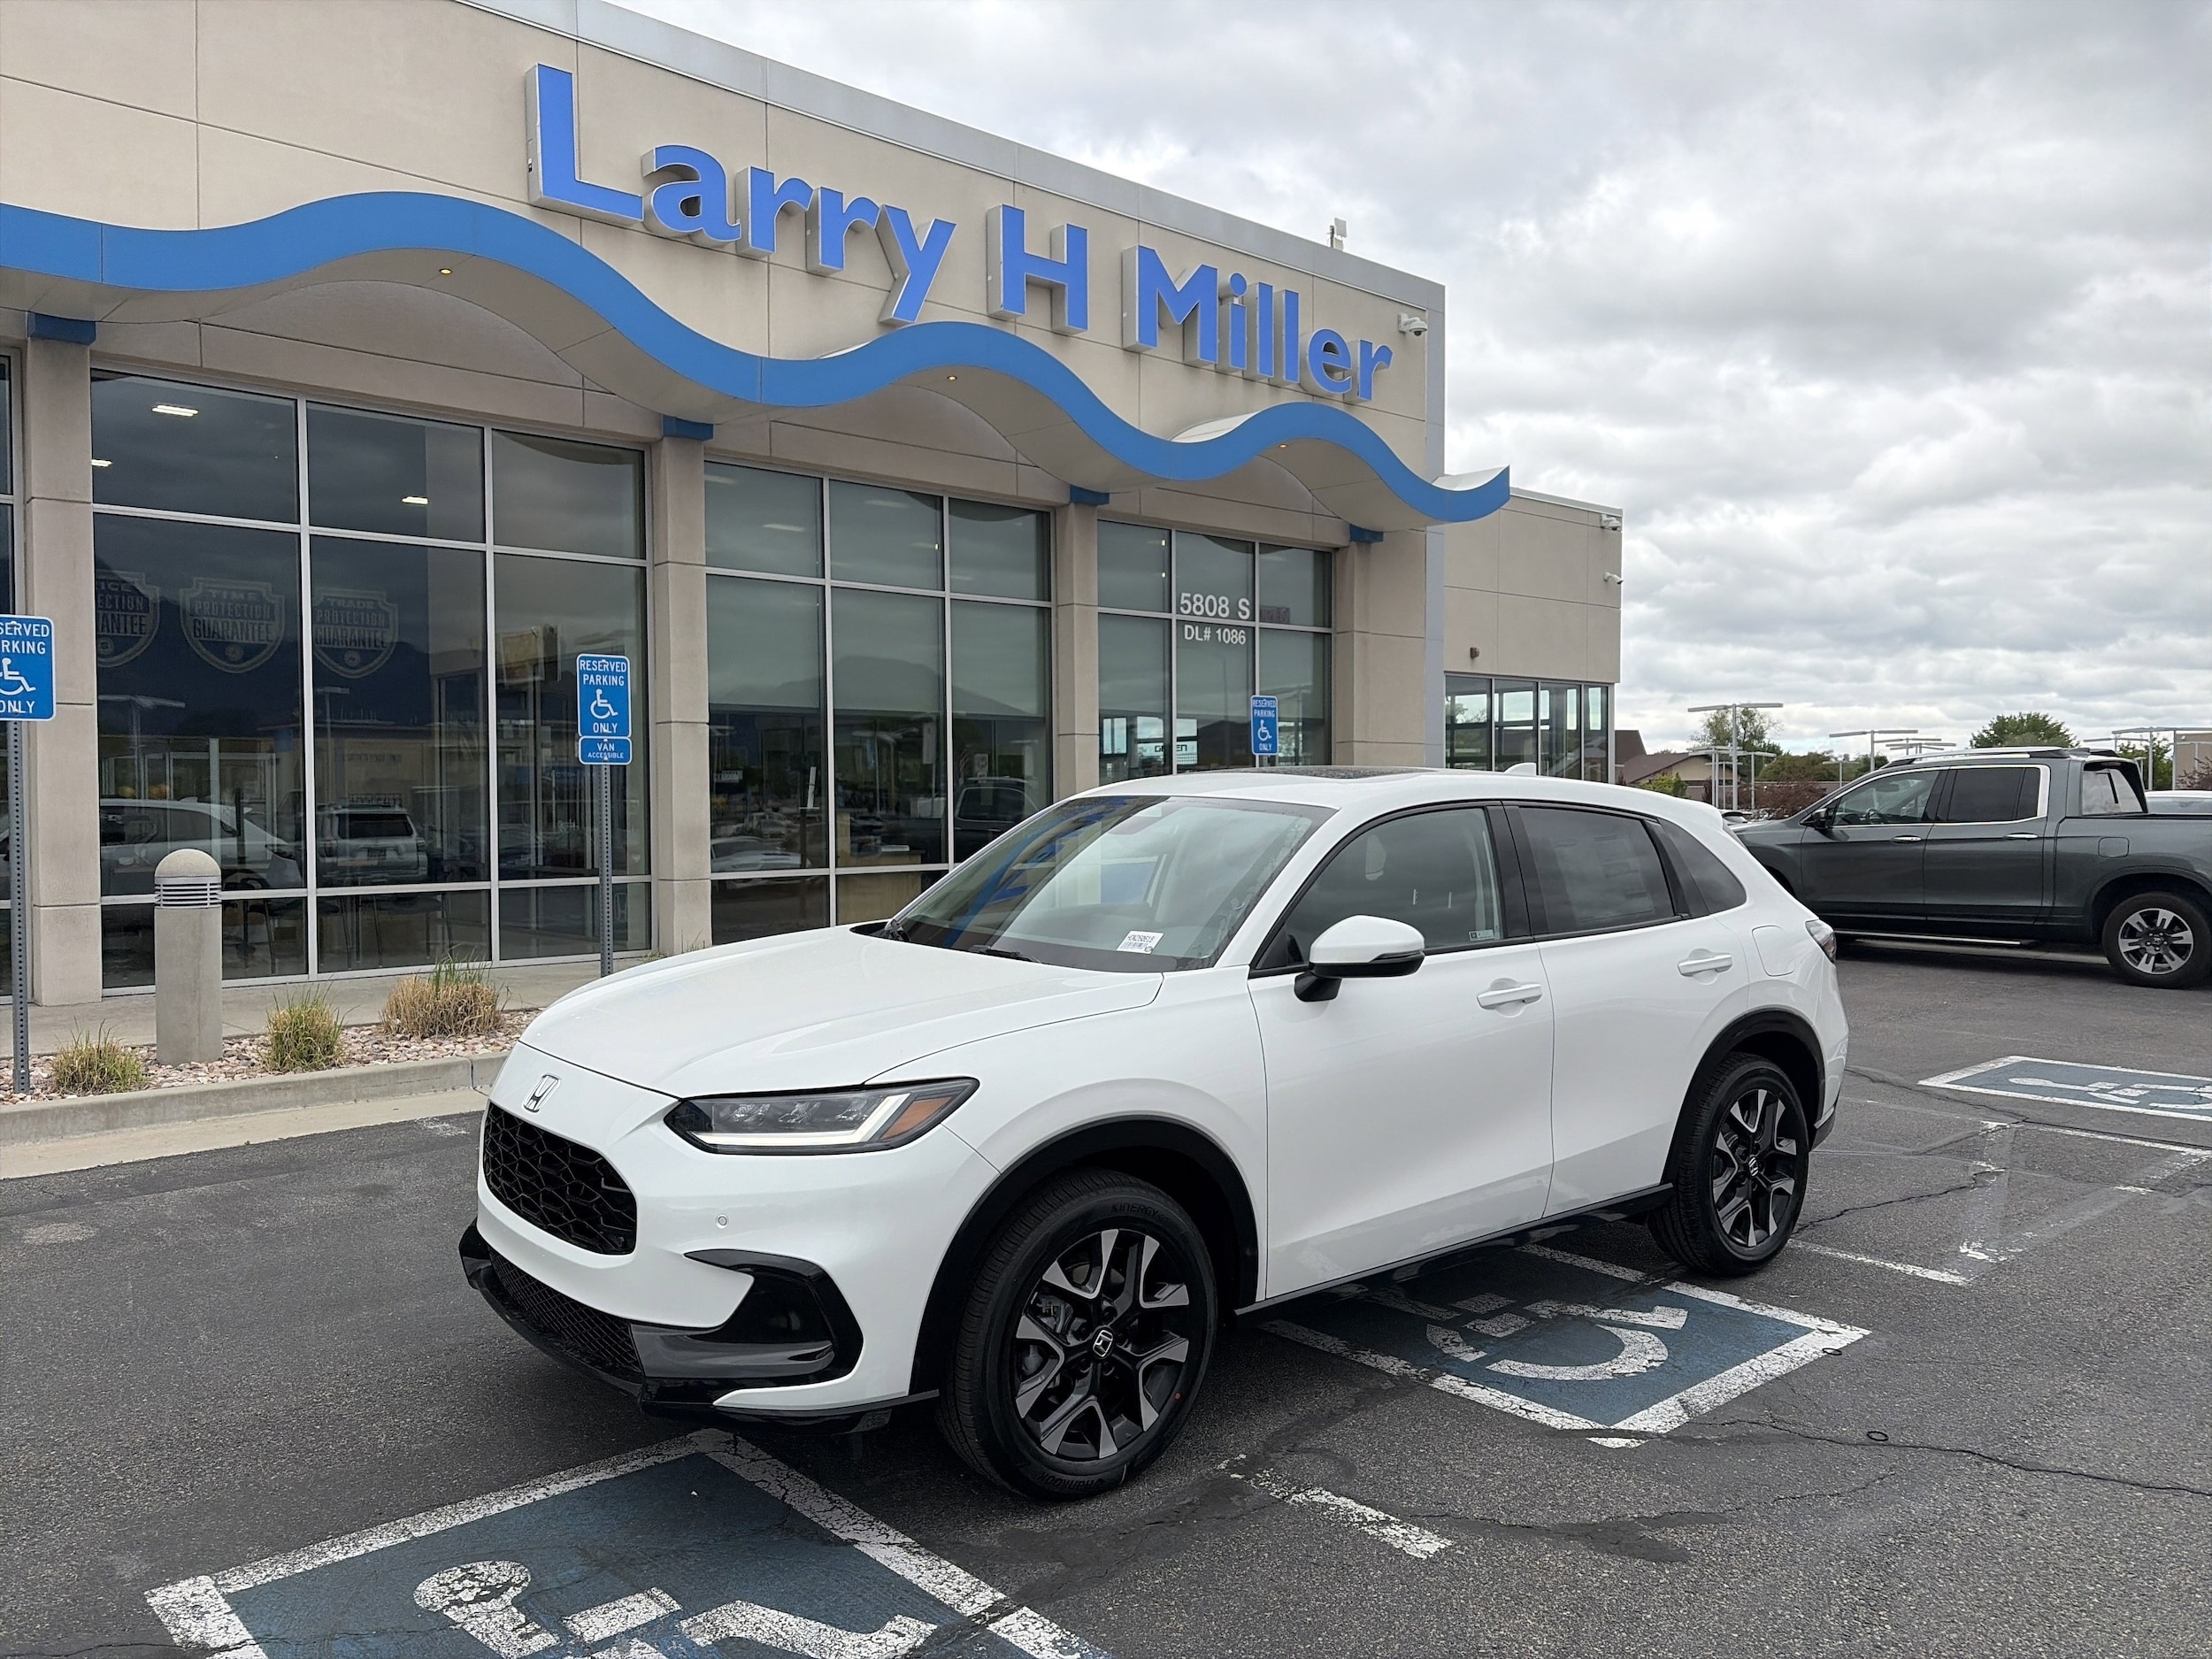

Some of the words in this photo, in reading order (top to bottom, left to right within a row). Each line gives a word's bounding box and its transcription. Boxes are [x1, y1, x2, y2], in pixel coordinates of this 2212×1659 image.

[526, 63, 956, 326] Larry
[987, 204, 1088, 334] H
[1122, 245, 1394, 403] Miller
[97, 594, 143, 611] ECTION
[209, 589, 256, 601] TIME
[195, 600, 271, 619] PROTECTION
[1179, 593, 1230, 618] 5808
[1238, 598, 1250, 619] S
[97, 612, 147, 634] ANTEE
[318, 610, 385, 626] PROTECTION
[193, 618, 273, 641] GUARANTEE
[315, 626, 388, 649] GUARANTEE
[1184, 625, 1210, 641] DL#
[1216, 627, 1247, 644] 1086
[1, 640, 46, 655] RKING
[580, 659, 626, 672] RESERVED
[583, 674, 625, 687] PARKING
[1252, 699, 1276, 708] RESERVED
[593, 723, 618, 733] ONLY
[597, 742, 615, 751] VAN
